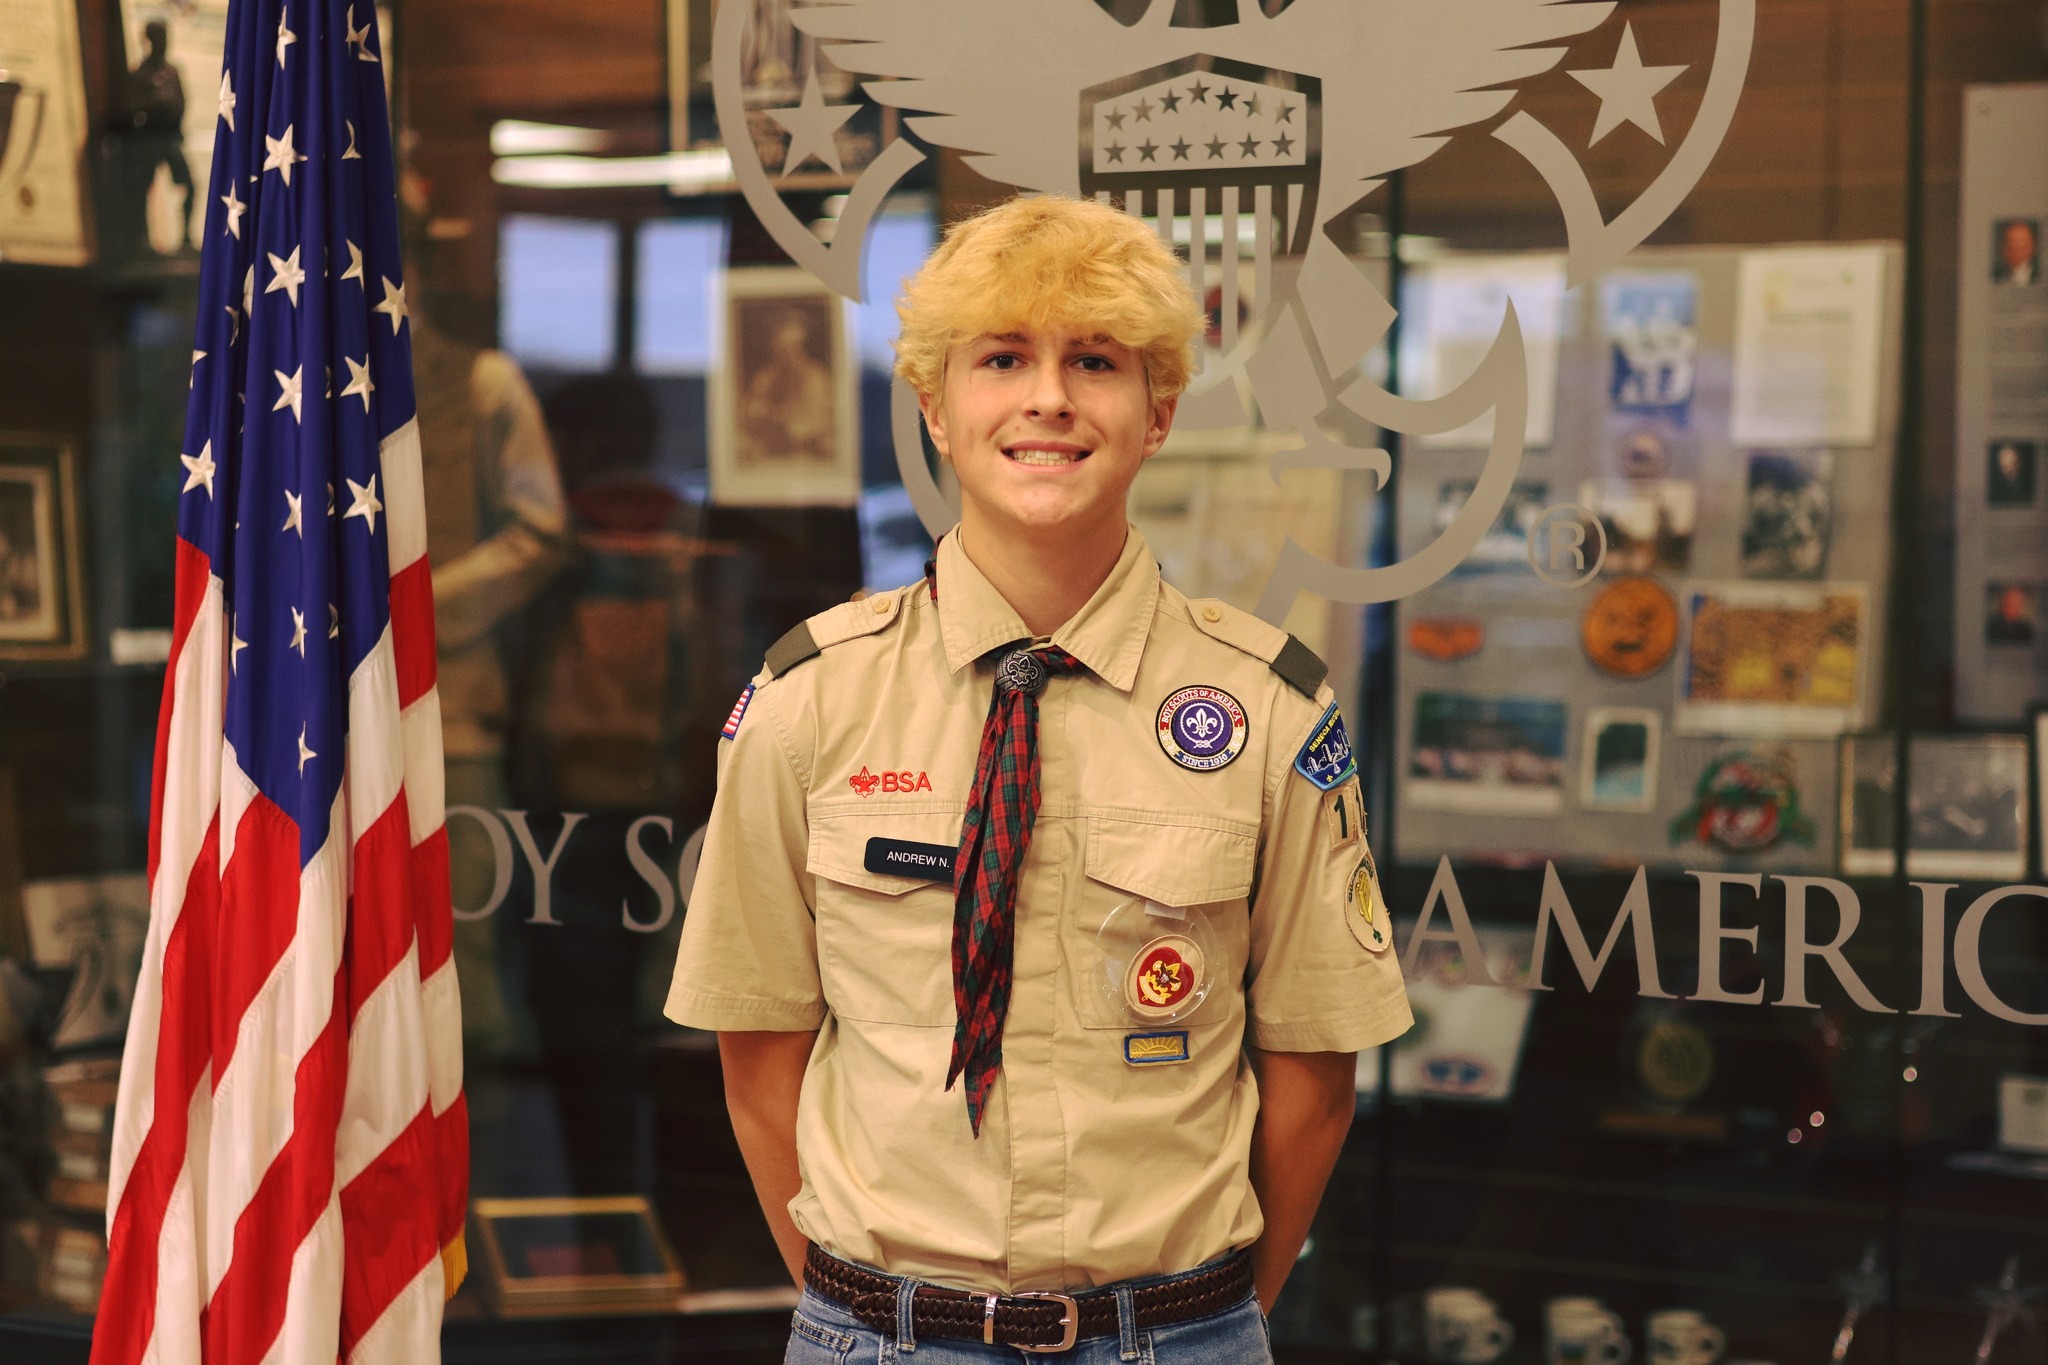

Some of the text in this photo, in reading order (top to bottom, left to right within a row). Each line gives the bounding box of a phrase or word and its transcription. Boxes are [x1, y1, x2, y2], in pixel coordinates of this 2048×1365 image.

[1161, 705, 1172, 723] BOY
[1169, 690, 1199, 709] SCOUTS
[1207, 691, 1242, 722] AMERICA
[1309, 725, 1331, 752] SENECA
[1182, 753, 1228, 768] SINCE 1910
[881, 771, 932, 793] BSA
[446, 805, 590, 926] OY
[886, 850, 950, 868] ANDREW N.
